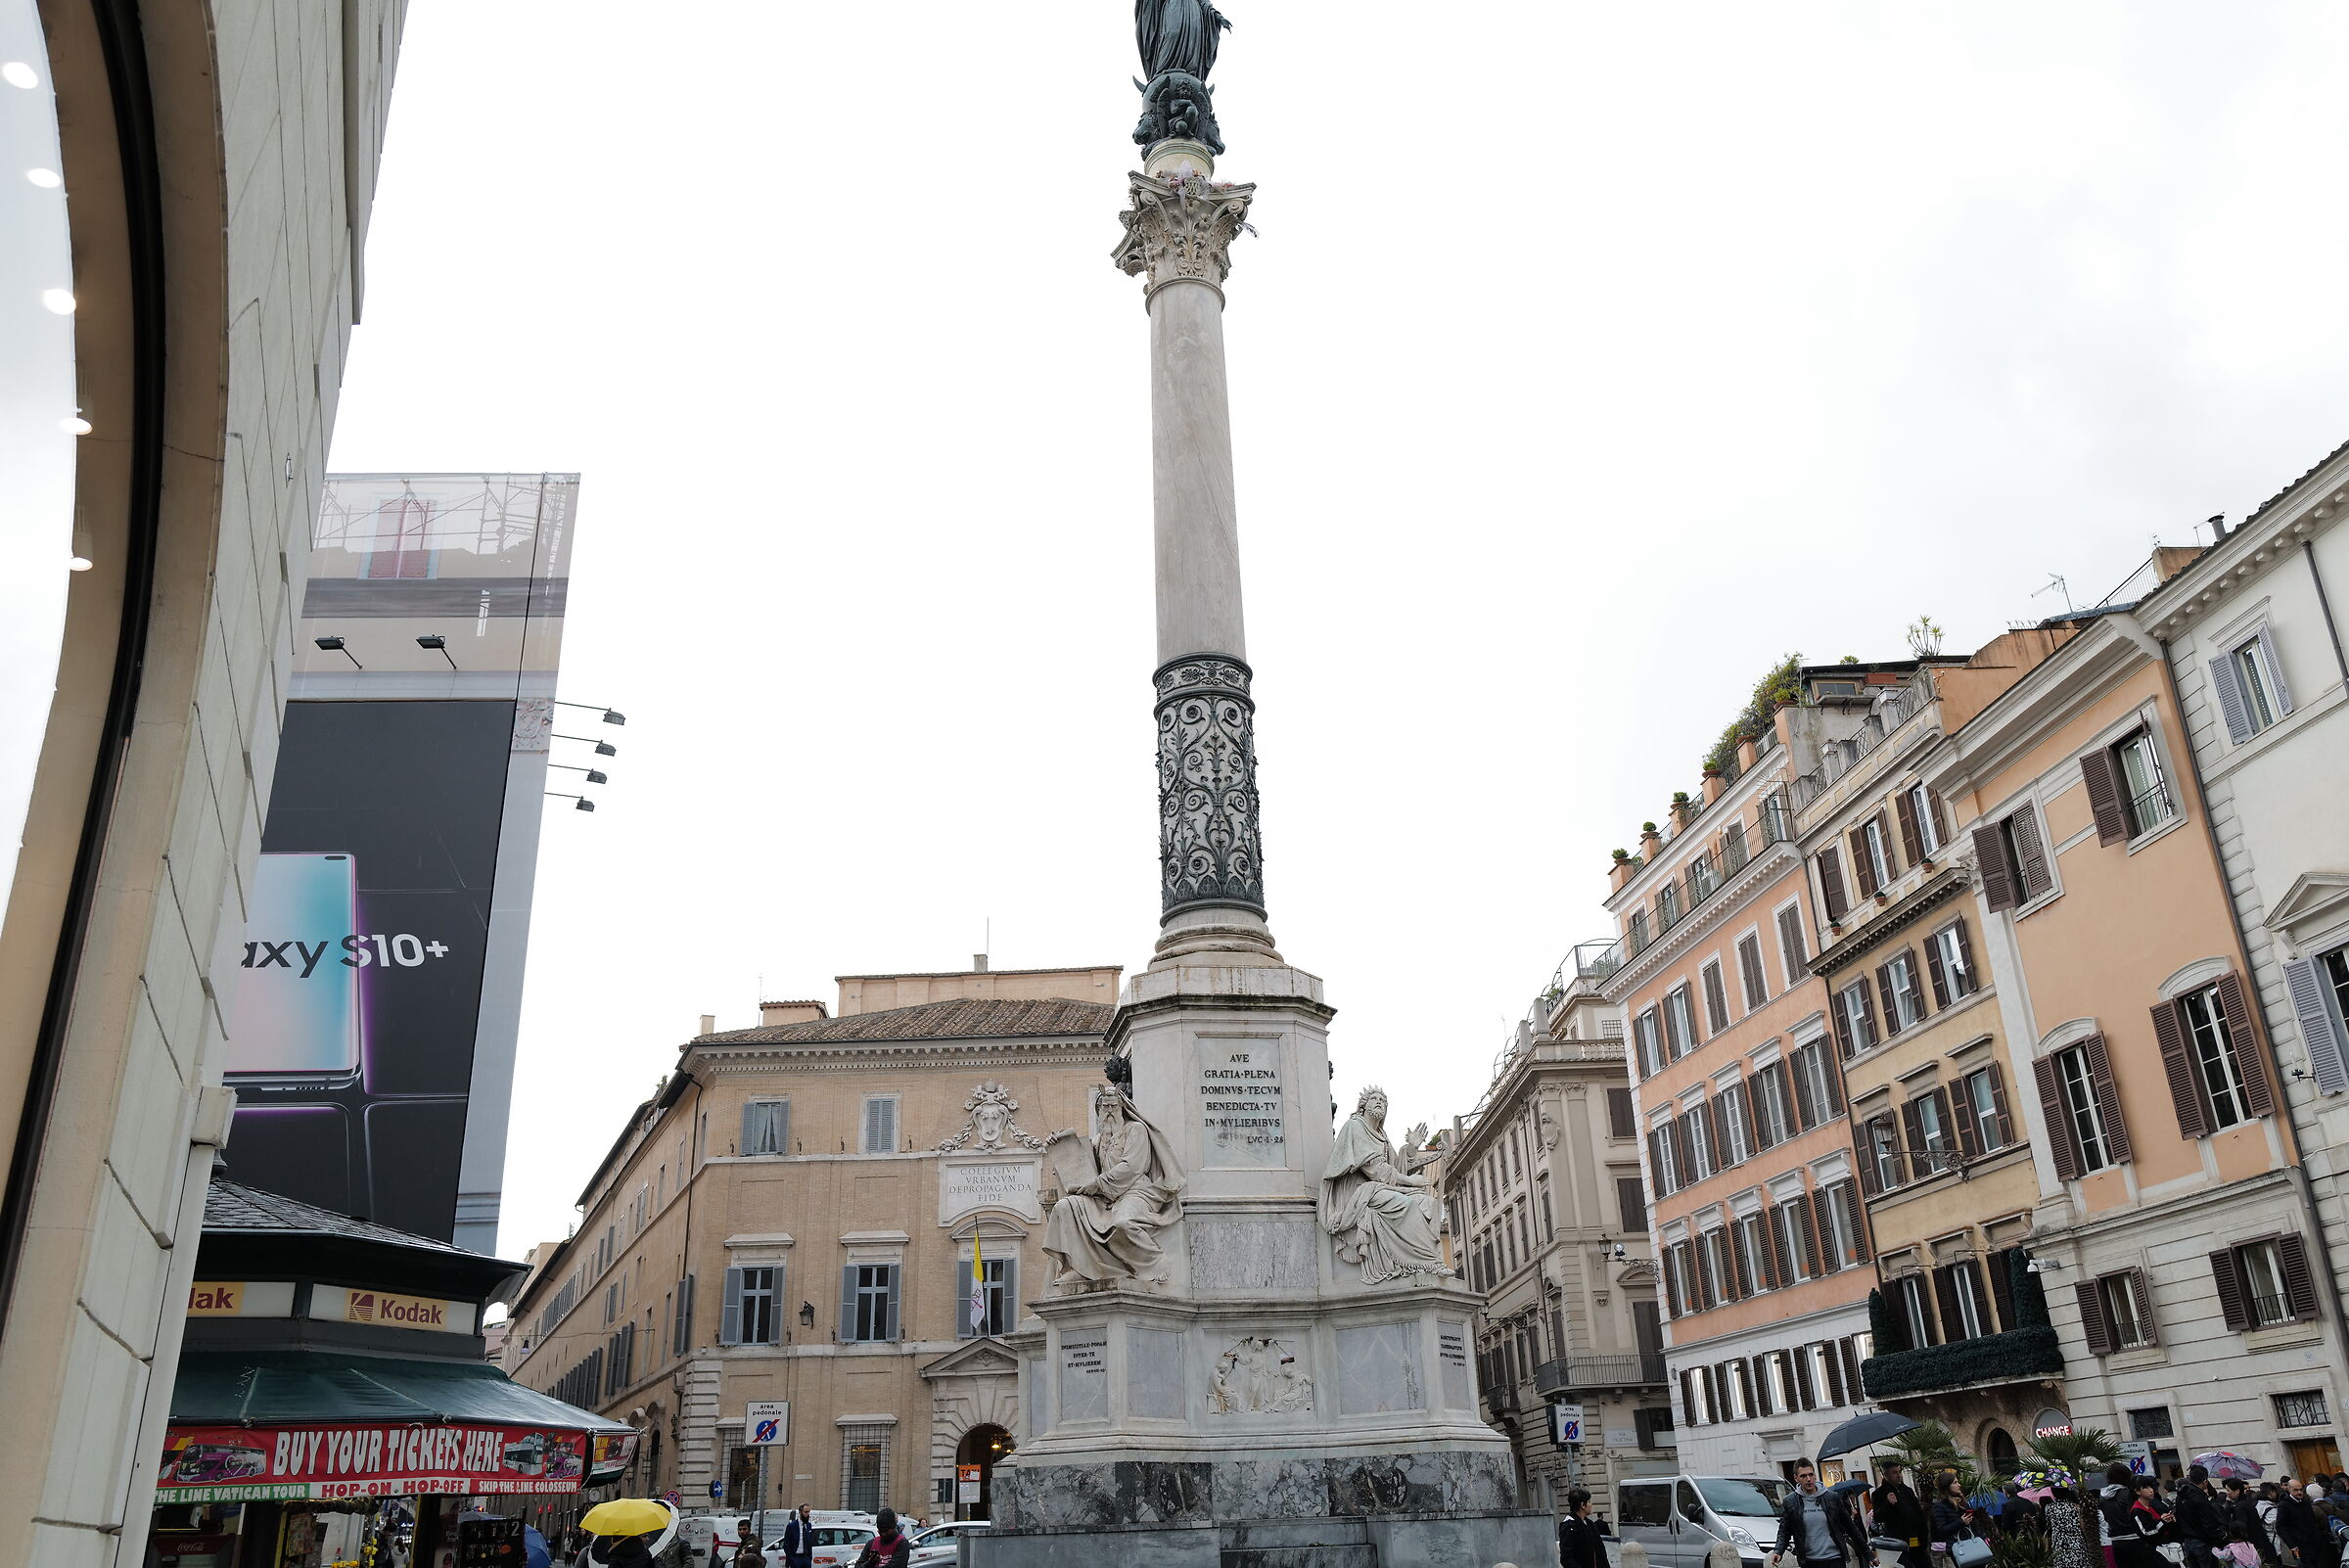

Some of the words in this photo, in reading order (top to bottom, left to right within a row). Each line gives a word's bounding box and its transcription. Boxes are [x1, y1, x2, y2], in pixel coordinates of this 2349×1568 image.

[340, 934, 449, 968] S10+
[1229, 1054, 1250, 1063] AVE
[960, 1166, 1021, 1176] COLLEGIVM
[965, 1175, 1016, 1183] VRBANVM
[978, 1193, 1003, 1202] FIDE
[380, 1299, 442, 1324] Kodak
[2036, 1425, 2072, 1439] CHANGE
[273, 1431, 324, 1476] BUY
[327, 1429, 384, 1474] YOUR
[388, 1428, 463, 1472] TICKETS
[462, 1431, 504, 1473] HERE
[179, 1487, 210, 1502] LINE
[212, 1485, 271, 1501] VATICAN
[273, 1484, 306, 1499] TOUR
[321, 1481, 392, 1498] HOP-ON
[402, 1480, 465, 1495] HOP-OFF
[479, 1480, 498, 1493] SKIP
[499, 1480, 515, 1493] THE
[534, 1480, 577, 1493] COLOSSEUM
